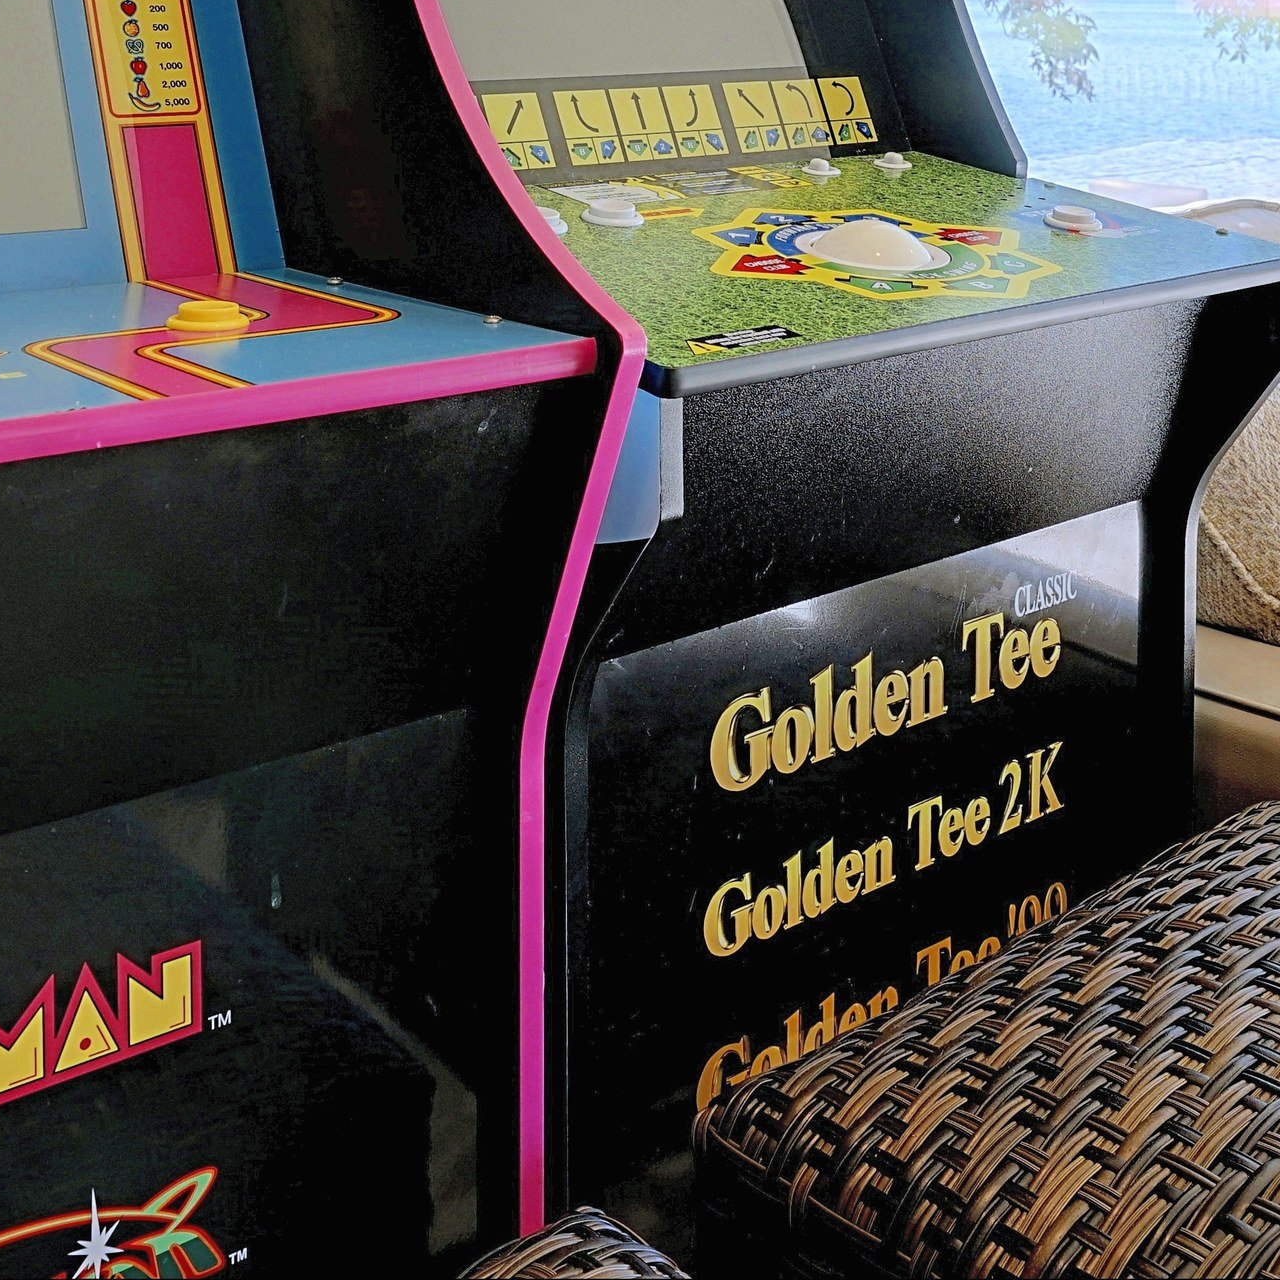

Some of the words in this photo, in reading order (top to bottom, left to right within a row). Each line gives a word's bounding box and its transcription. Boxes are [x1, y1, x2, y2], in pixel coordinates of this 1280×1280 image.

[149, 5, 166, 13] 200
[152, 23, 169, 31] 500
[155, 42, 172, 50] 700
[159, 62, 183, 71] 1,000
[162, 80, 187, 89] 2,000
[165, 98, 190, 107] 5,000
[871, 280, 896, 290] A
[1015, 572, 1078, 620] CLASSIC
[710, 651, 949, 792] Golden
[963, 612, 1063, 704] Tee
[703, 835, 896, 957] Golden
[907, 795, 992, 873] Tee
[999, 741, 1065, 836] 2K
[208, 1010, 232, 1031] TM
[228, 1247, 248, 1266] TM
